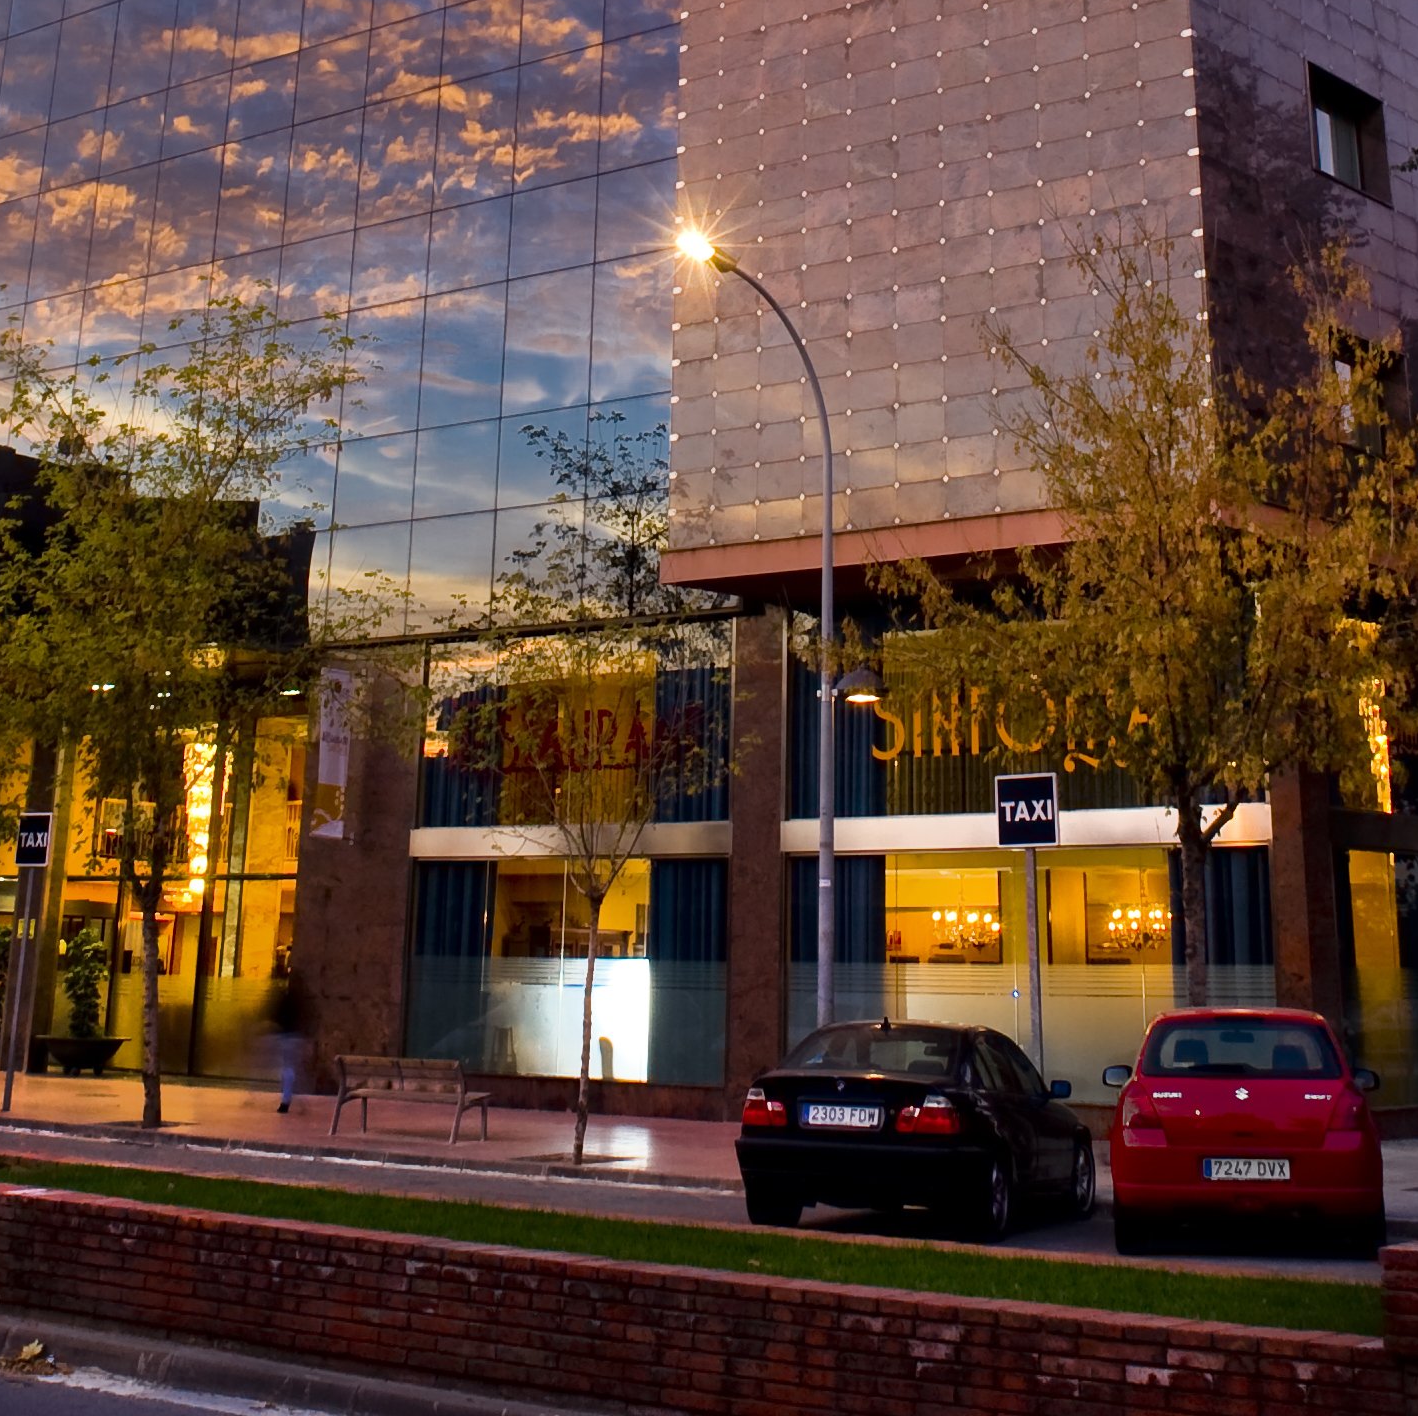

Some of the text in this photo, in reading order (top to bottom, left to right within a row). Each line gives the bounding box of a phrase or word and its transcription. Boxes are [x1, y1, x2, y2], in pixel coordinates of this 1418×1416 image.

[1000, 798, 1053, 823] TAXI
[20, 831, 48, 848] TAXI
[811, 1106, 846, 1122] 2303
[1213, 1160, 1287, 1177] 7247 DVX
